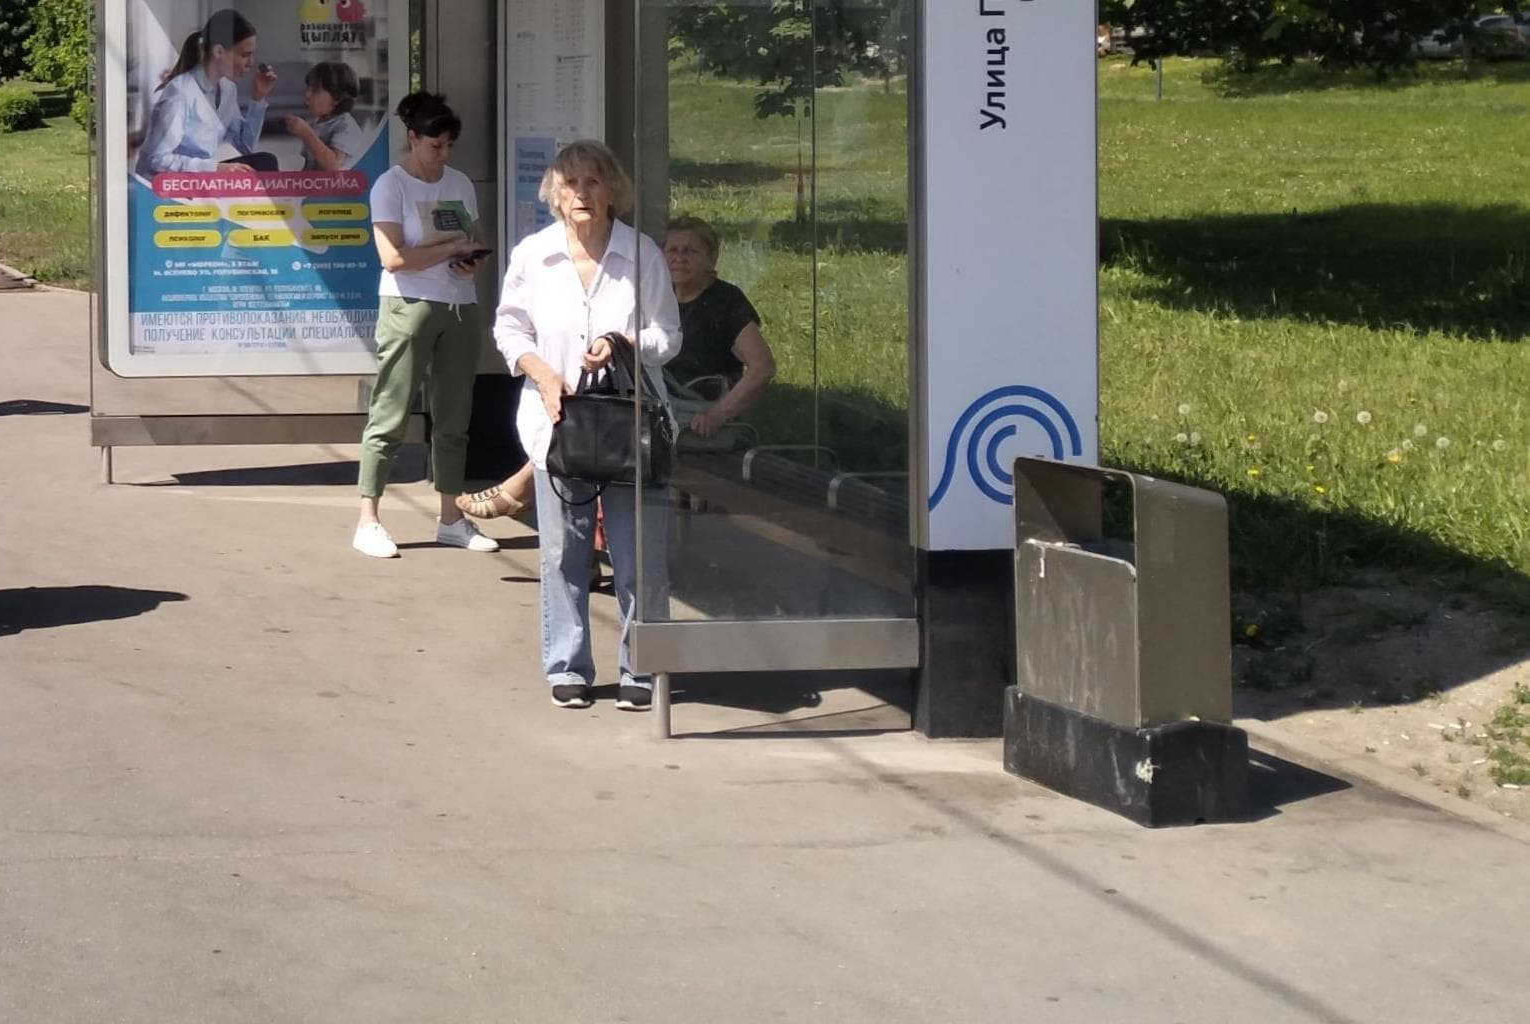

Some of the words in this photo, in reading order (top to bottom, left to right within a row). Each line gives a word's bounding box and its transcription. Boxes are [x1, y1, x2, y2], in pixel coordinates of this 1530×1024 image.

[979, 27, 1010, 130] Улица
[162, 178, 252, 191] БЕСПЛАТНАЯ
[254, 177, 360, 192] ДИАГНОСТИКА
[141, 313, 192, 326] ИМЕЮТСЯ
[144, 328, 206, 342] ПОЛУЧЕНИЕ
[211, 327, 297, 341] КОНСУЛЬТАЦИИ
